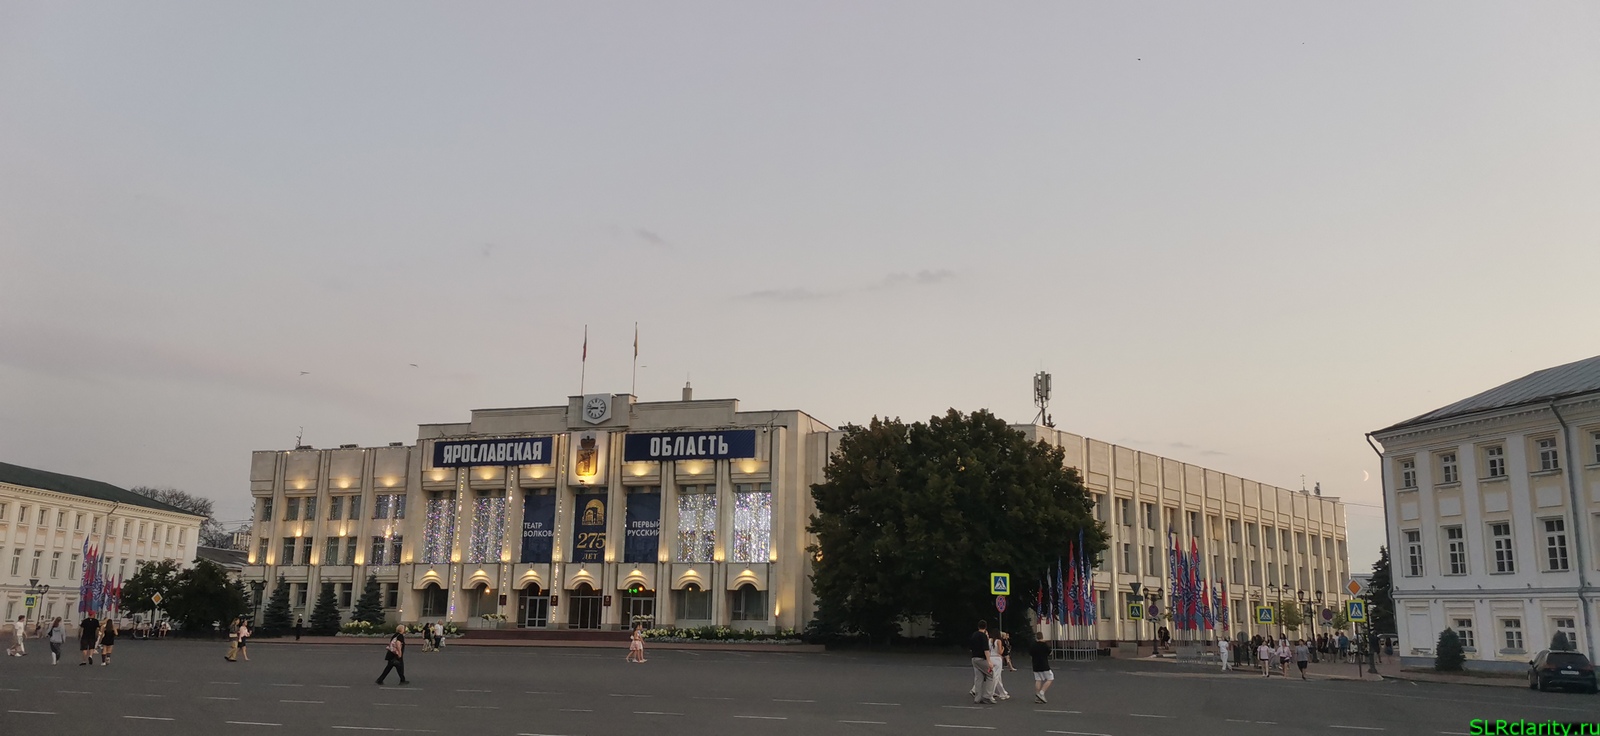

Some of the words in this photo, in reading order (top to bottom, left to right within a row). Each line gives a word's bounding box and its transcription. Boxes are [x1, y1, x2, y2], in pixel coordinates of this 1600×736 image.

[443, 441, 542, 464] ЯРОСЛАВСКАЯ
[650, 435, 729, 457] ОБЛАСТЬ
[576, 532, 606, 549] 275
